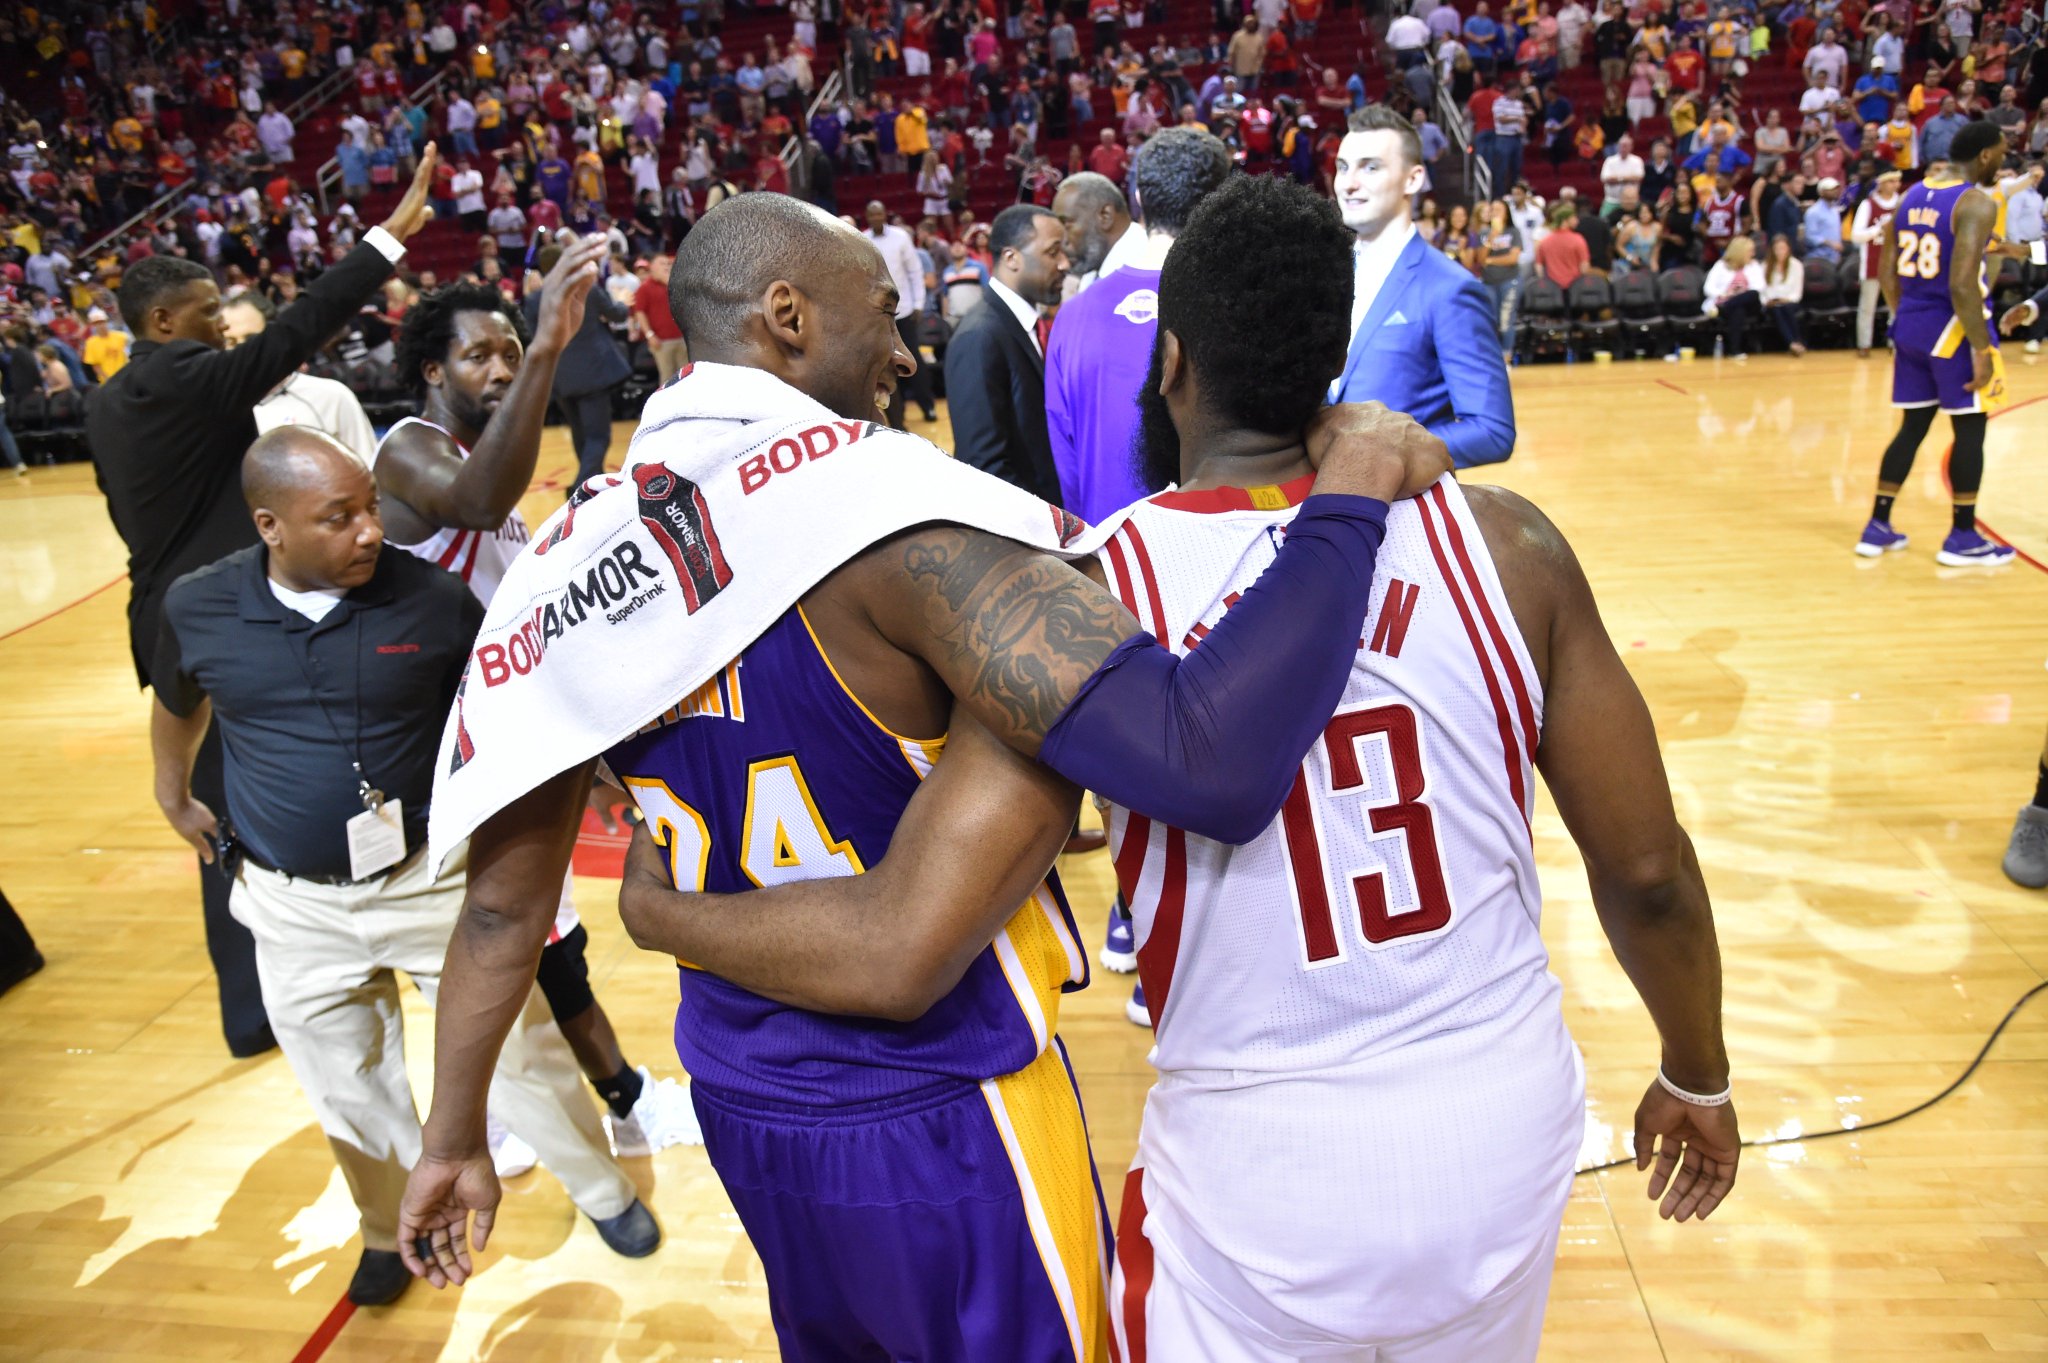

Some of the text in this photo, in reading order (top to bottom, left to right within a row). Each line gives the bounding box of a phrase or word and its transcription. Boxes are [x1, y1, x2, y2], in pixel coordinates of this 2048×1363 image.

[1897, 229, 1941, 279] 28
[476, 540, 660, 688] BODYARMOR
[606, 582, 666, 625] SuperDrink
[622, 755, 866, 893] 24
[1280, 698, 1457, 970] 13
